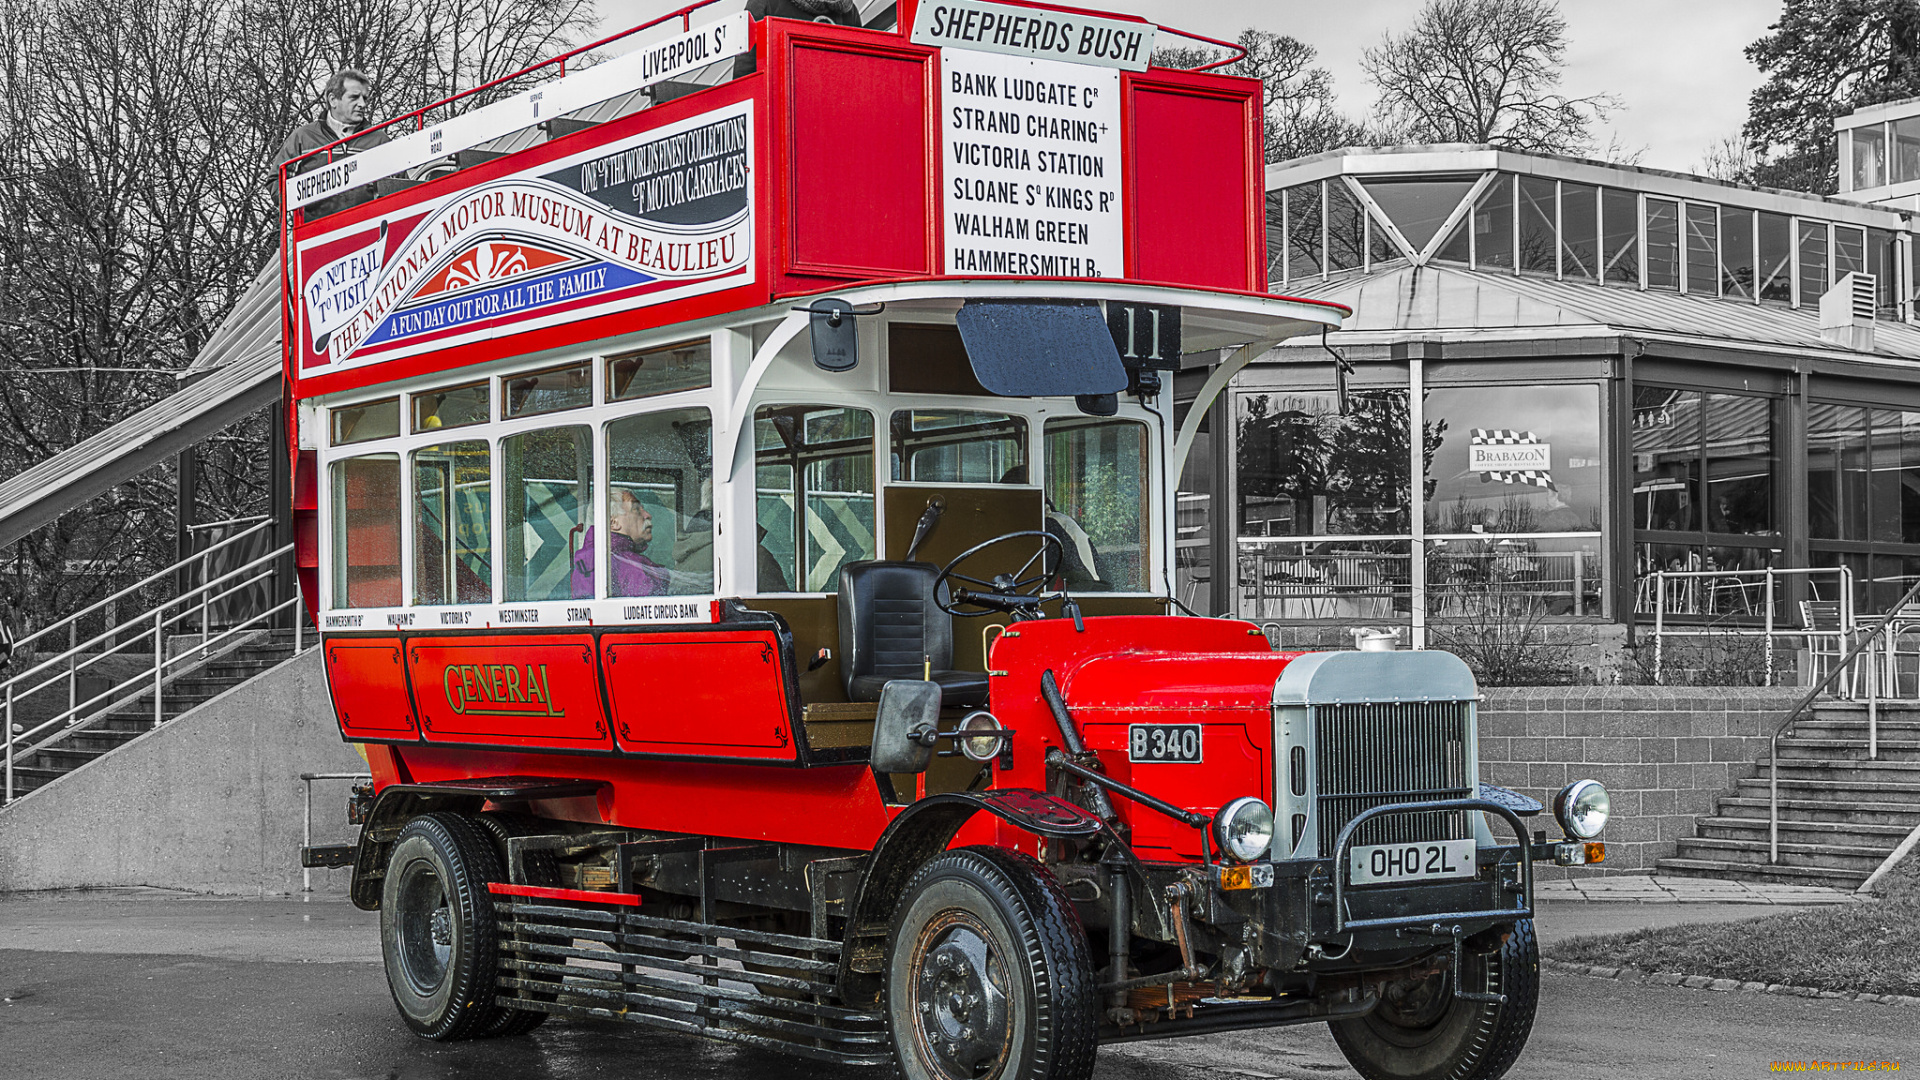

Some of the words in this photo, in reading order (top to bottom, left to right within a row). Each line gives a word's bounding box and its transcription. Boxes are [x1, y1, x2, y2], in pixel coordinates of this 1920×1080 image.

[930, 6, 1073, 53] SHEPHERDS
[1077, 26, 1142, 62] BUSH
[643, 32, 709, 80] LIVERPOOL
[952, 71, 997, 97] BANK
[1004, 77, 1077, 107] LUDGATE
[430, 129, 443, 142] LAWN
[953, 106, 1020, 135] STRAND
[430, 142, 443, 155] ROAD
[581, 161, 598, 194] ONE
[598, 158, 609, 189] OF
[609, 152, 626, 186] THE
[659, 132, 687, 172] FINEST
[687, 116, 745, 164] COLLECTIONS
[953, 141, 1031, 171] VICTORIA
[1038, 150, 1104, 178] STATION
[296, 166, 342, 201] SHEPHERDS
[632, 181, 645, 214] OF
[646, 170, 685, 212] MOTOR
[686, 153, 745, 202] CARRIAGES
[953, 177, 1019, 205] SLOANE
[1046, 186, 1093, 212] KINGS
[954, 212, 1029, 240] WALHAM
[1036, 219, 1088, 245] GREEN
[310, 277, 324, 308] DO
[326, 261, 347, 292] NOT
[350, 248, 380, 279] FAIL
[333, 317, 361, 359] THE
[363, 233, 439, 332] NATIONAL
[442, 191, 506, 245] MOTOR
[511, 191, 595, 241] MUSEUM
[595, 221, 620, 261] AT
[626, 231, 737, 272] BEAULIEU
[954, 248, 1080, 277] HAMMERSMITH
[318, 297, 332, 324] TO
[334, 278, 369, 314] VISIT
[390, 318, 399, 337] A
[399, 312, 422, 334] FUN
[424, 306, 446, 329] DAY
[447, 299, 473, 323] OUT
[474, 293, 500, 318] FOR
[501, 287, 526, 311] ALL
[527, 280, 555, 304] THE
[558, 267, 607, 298] FAMILY
[1124, 307, 1163, 360] 11
[325, 615, 358, 627] HAMMERSMITH
[387, 613, 409, 626] WALHAM
[440, 612, 463, 624] VICTORIA
[499, 609, 539, 623] WESTMINSTER
[567, 607, 592, 622] STRAND
[623, 605, 652, 620] LUDGATE
[653, 604, 678, 619] CIRCUS
[680, 603, 698, 618] BANK
[443, 664, 565, 718] GENERAL
[1132, 729, 1148, 758] B
[1151, 729, 1197, 759] 340
[1371, 847, 1421, 878] OHO
[1425, 846, 1456, 874] 2L
